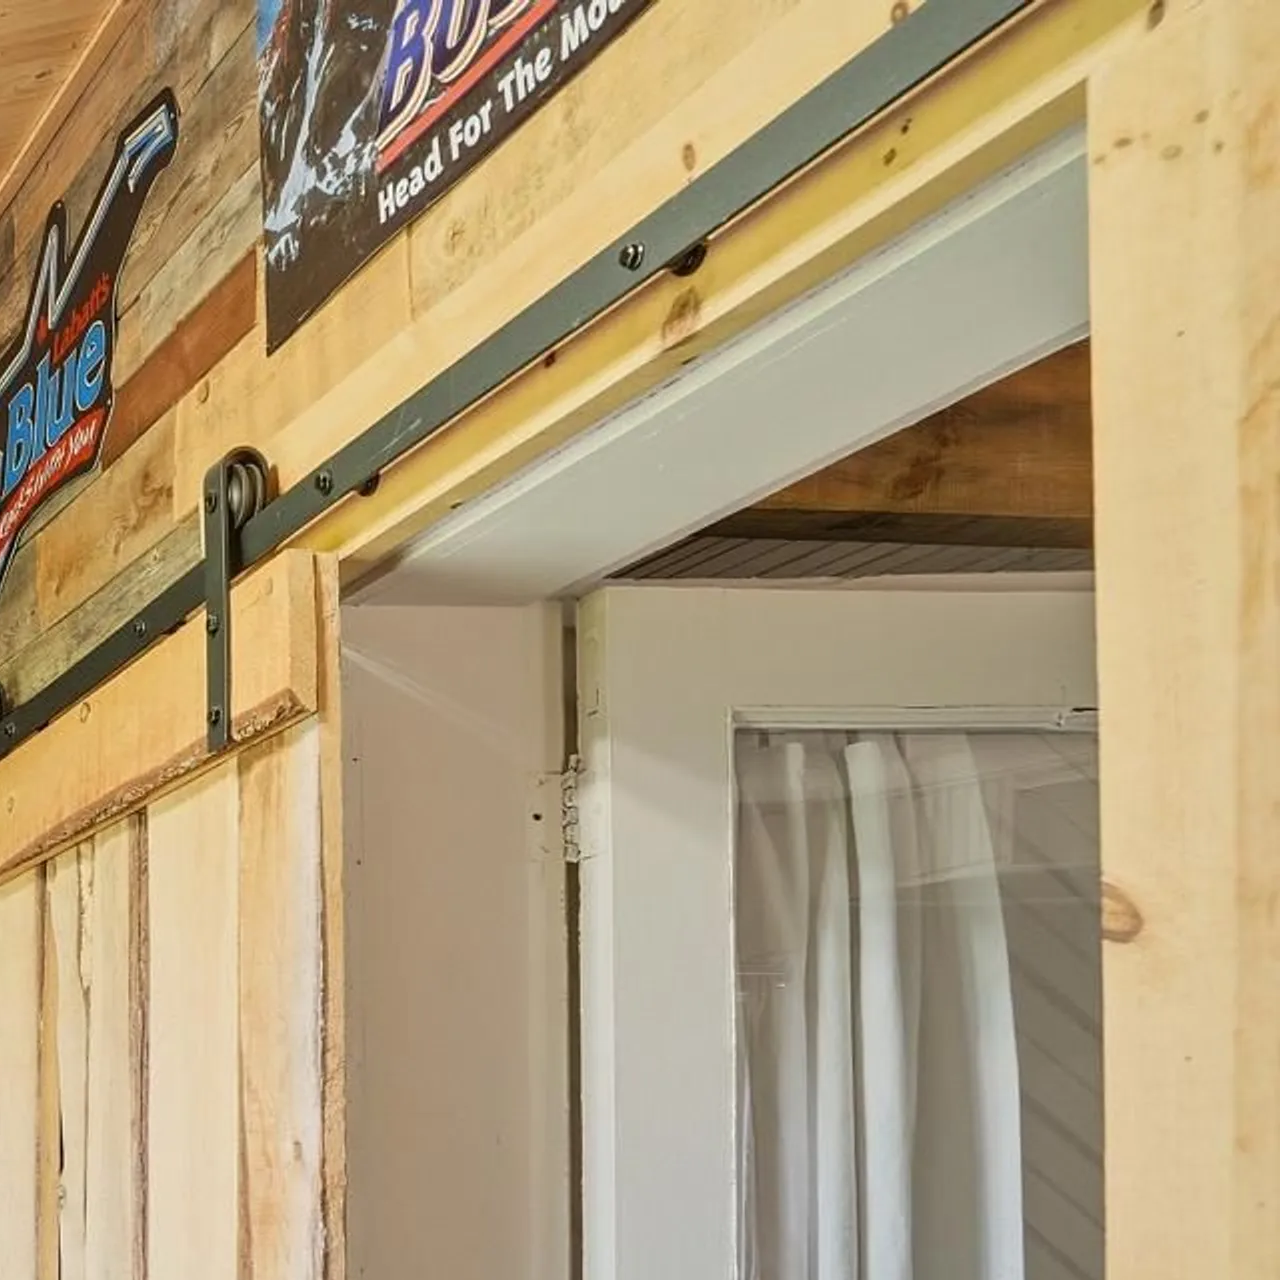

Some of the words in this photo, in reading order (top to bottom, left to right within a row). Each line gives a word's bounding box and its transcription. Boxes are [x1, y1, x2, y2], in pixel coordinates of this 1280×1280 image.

[378, 147, 444, 224] Head
[449, 98, 493, 161] For
[497, 47, 553, 113] The
[0, 319, 107, 501] Blue
